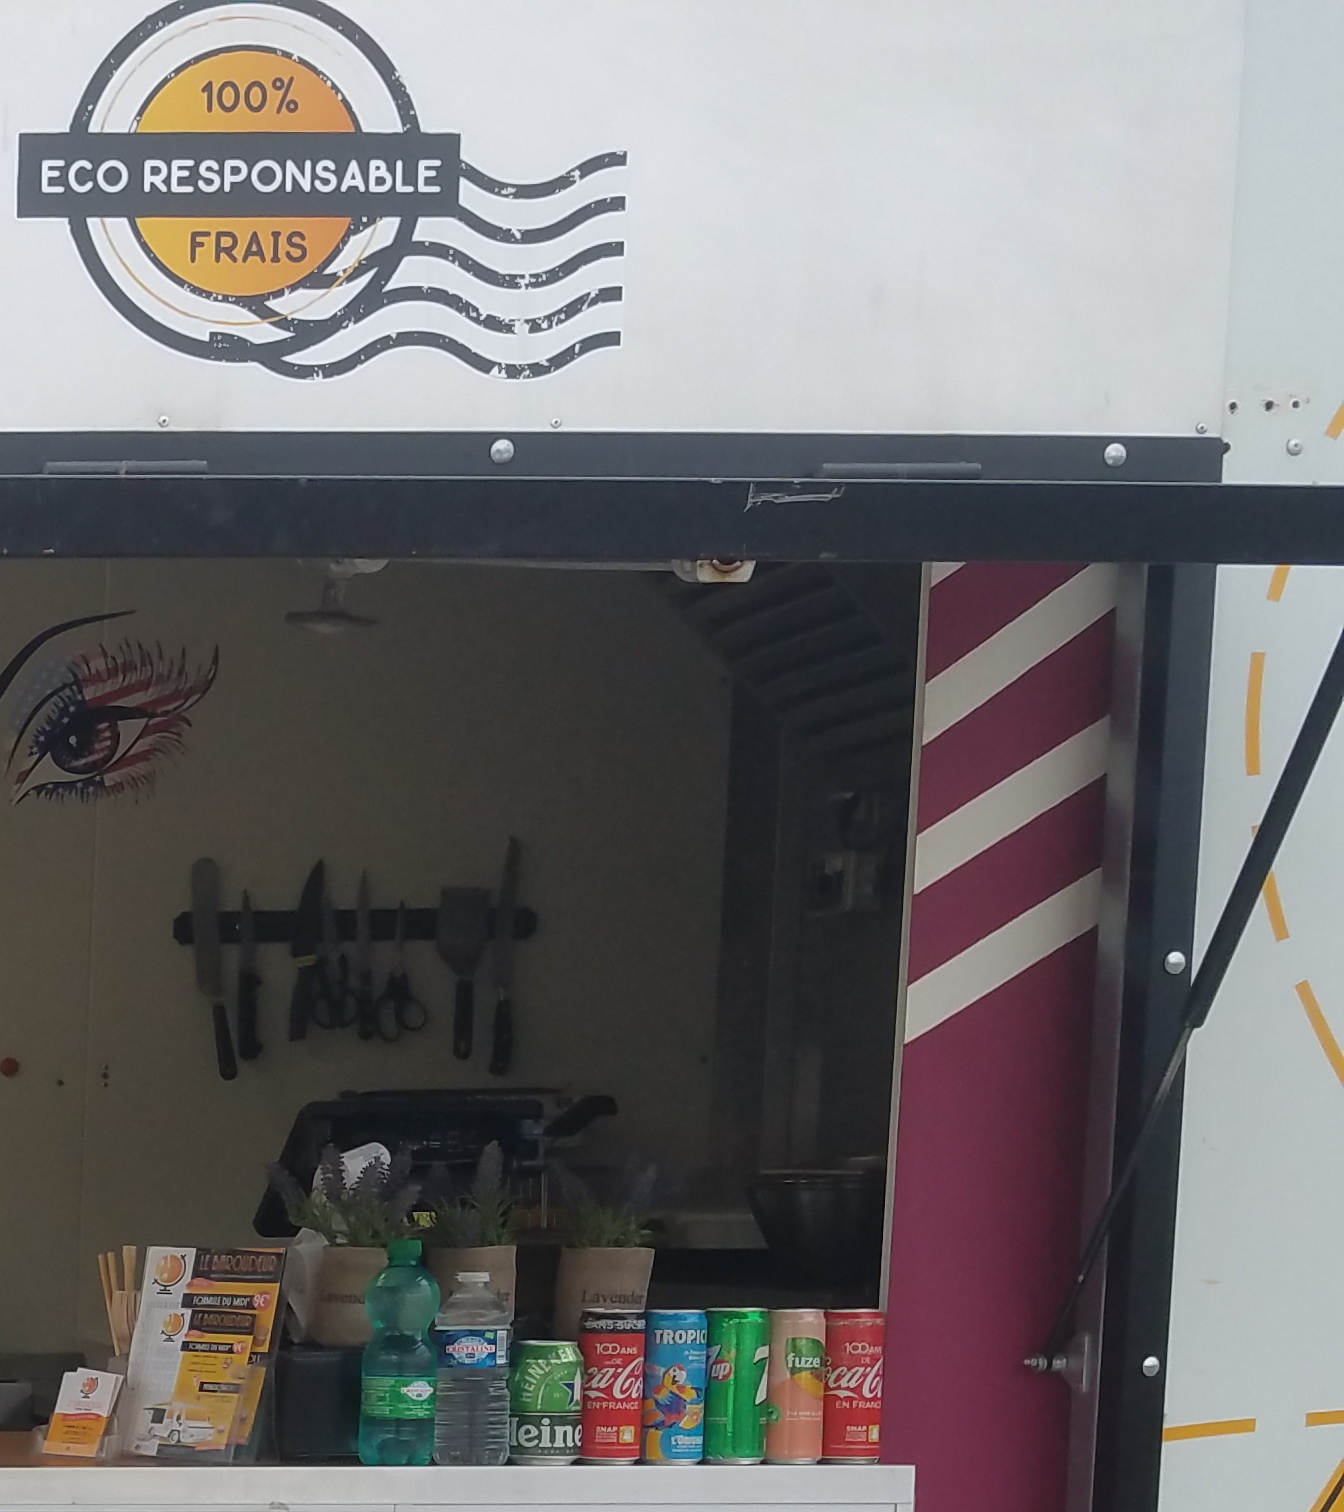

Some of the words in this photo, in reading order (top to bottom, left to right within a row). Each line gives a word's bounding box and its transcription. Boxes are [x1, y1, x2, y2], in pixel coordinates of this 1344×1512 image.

[201, 76, 299, 114] 100%
[40, 159, 129, 194] ECO
[143, 159, 442, 194] RESPONSABLE
[189, 230, 308, 264] FRAIS
[200, 1255, 210, 1270] LE
[654, 1330, 707, 1344] TROPIC
[522, 1346, 577, 1401] HEINEKEN
[787, 1353, 820, 1368] fuze
[510, 1418, 582, 1447] eine
